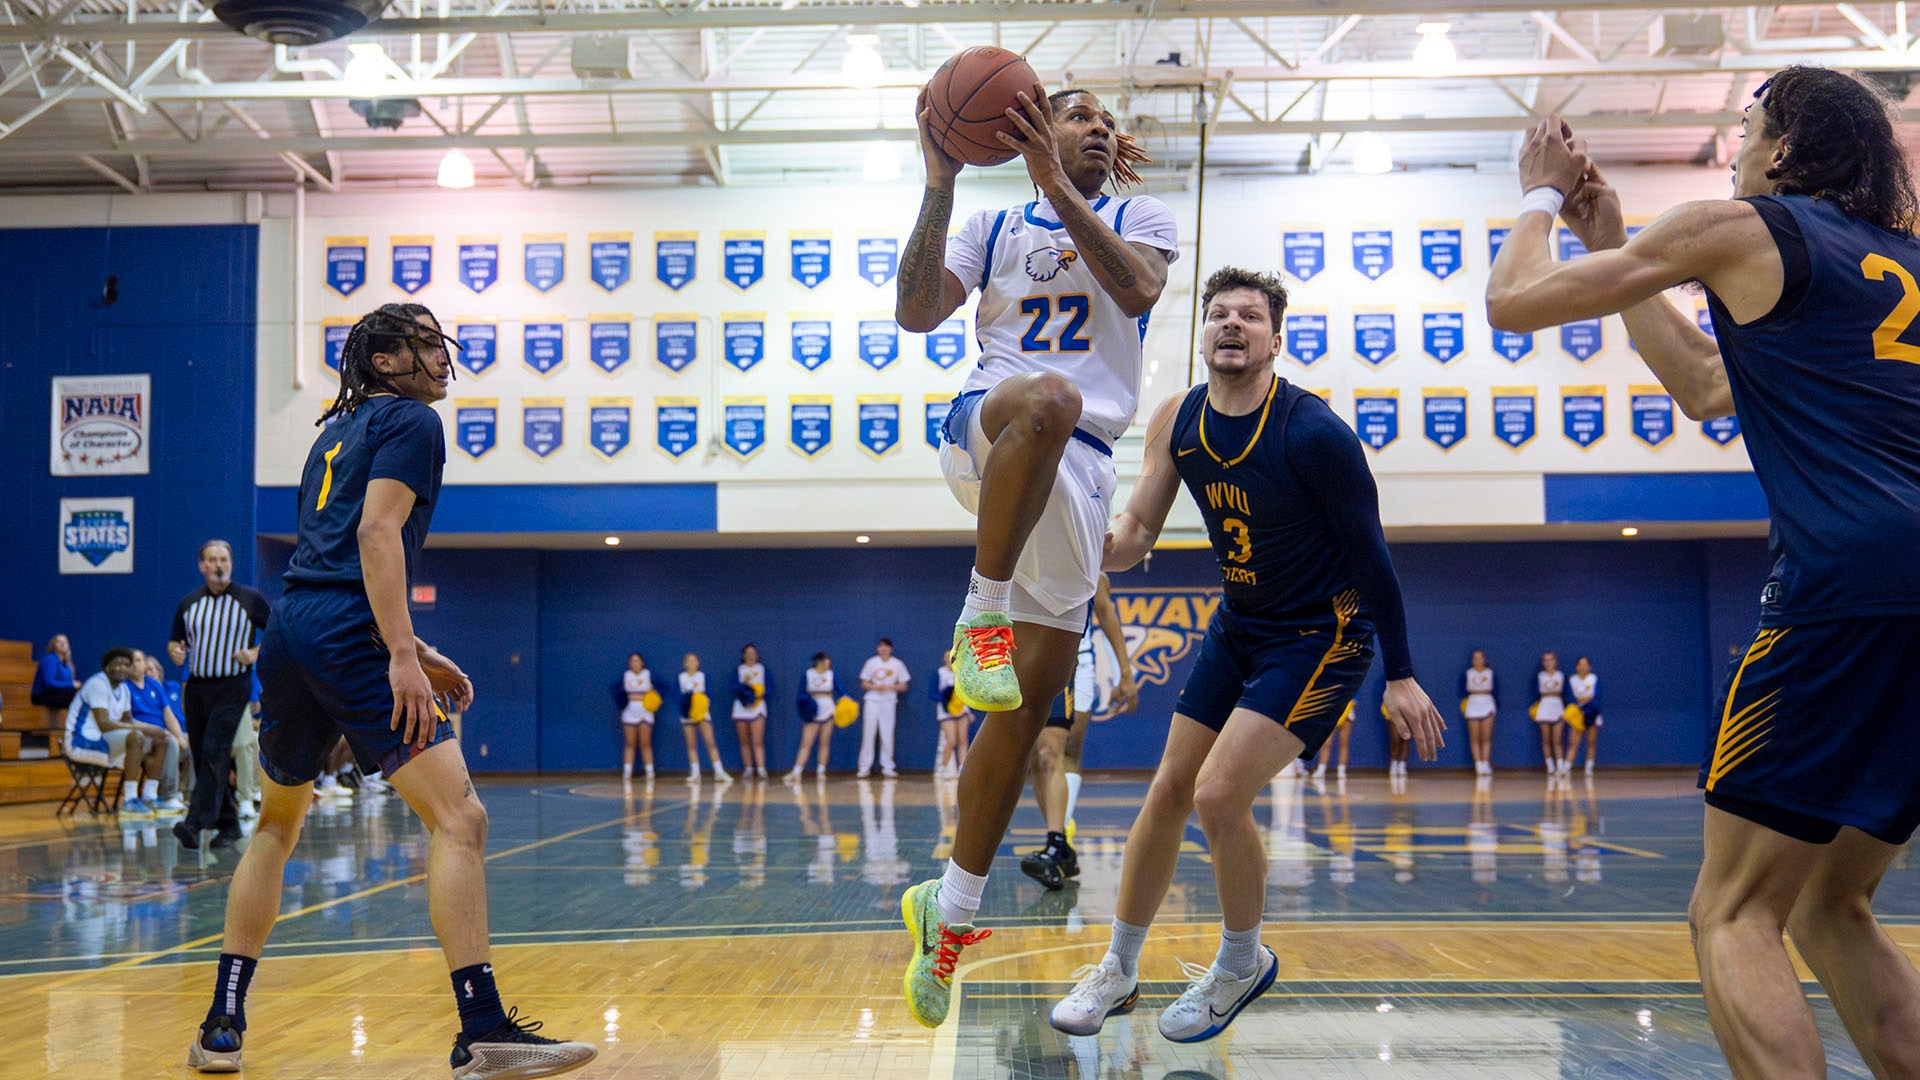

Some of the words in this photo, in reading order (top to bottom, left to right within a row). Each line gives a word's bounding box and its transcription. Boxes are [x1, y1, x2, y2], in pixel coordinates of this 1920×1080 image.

[1018, 292, 1092, 354] 22
[1860, 252, 1920, 365] 2
[64, 397, 138, 424] NAIA
[69, 439, 80, 448] of
[83, 438, 133, 448] Character
[73, 429, 129, 440] Champions
[316, 441, 342, 511] 1
[1205, 481, 1251, 517] WVU
[66, 526, 128, 547] STATES
[1223, 518, 1253, 564] 3
[1115, 596, 1221, 631] WAY
